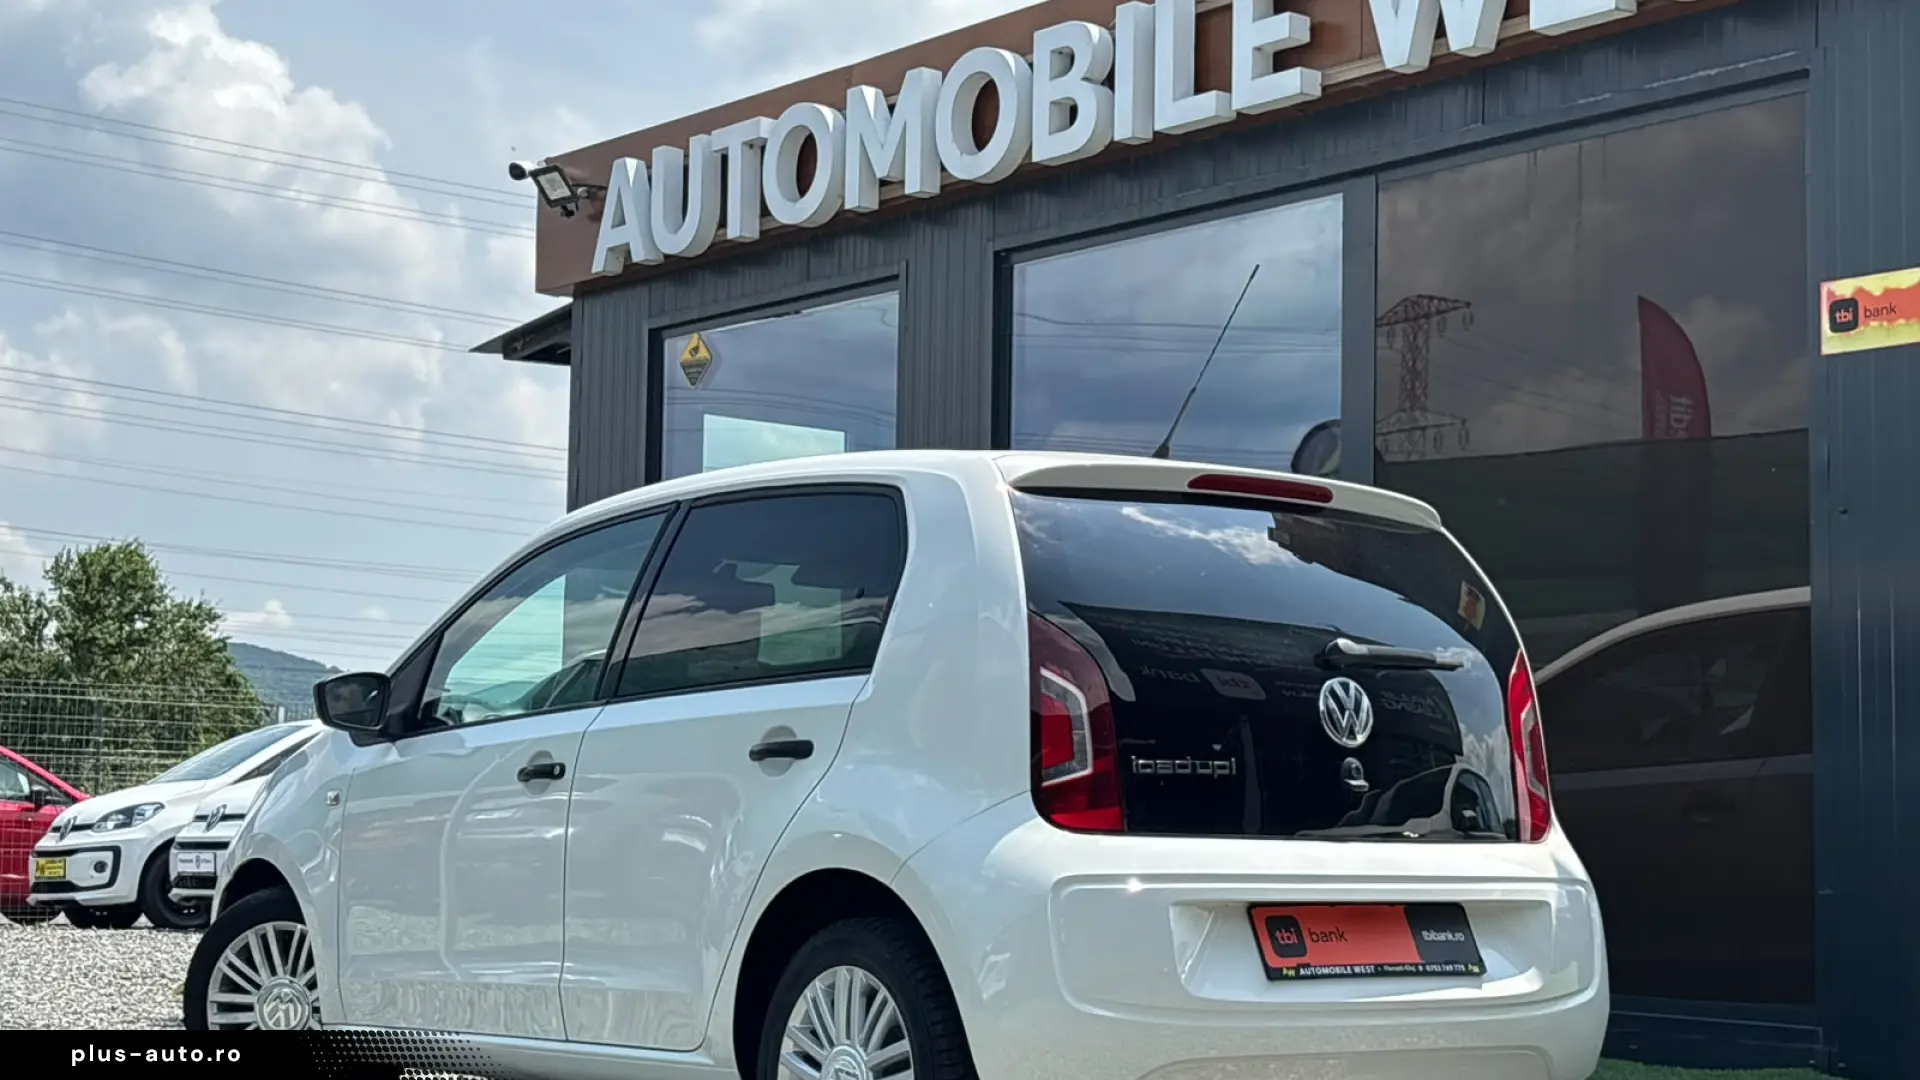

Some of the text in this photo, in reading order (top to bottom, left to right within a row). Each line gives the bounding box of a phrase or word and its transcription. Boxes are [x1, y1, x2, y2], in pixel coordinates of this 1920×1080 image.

[591, 0, 1322, 276] AUTOMOBILE
[1835, 302, 1897, 323] tbi bank
[1275, 926, 1348, 945] tbi bank
[1300, 965, 1352, 976] AUTOMOBILE
[1353, 964, 1375, 974] WEST
